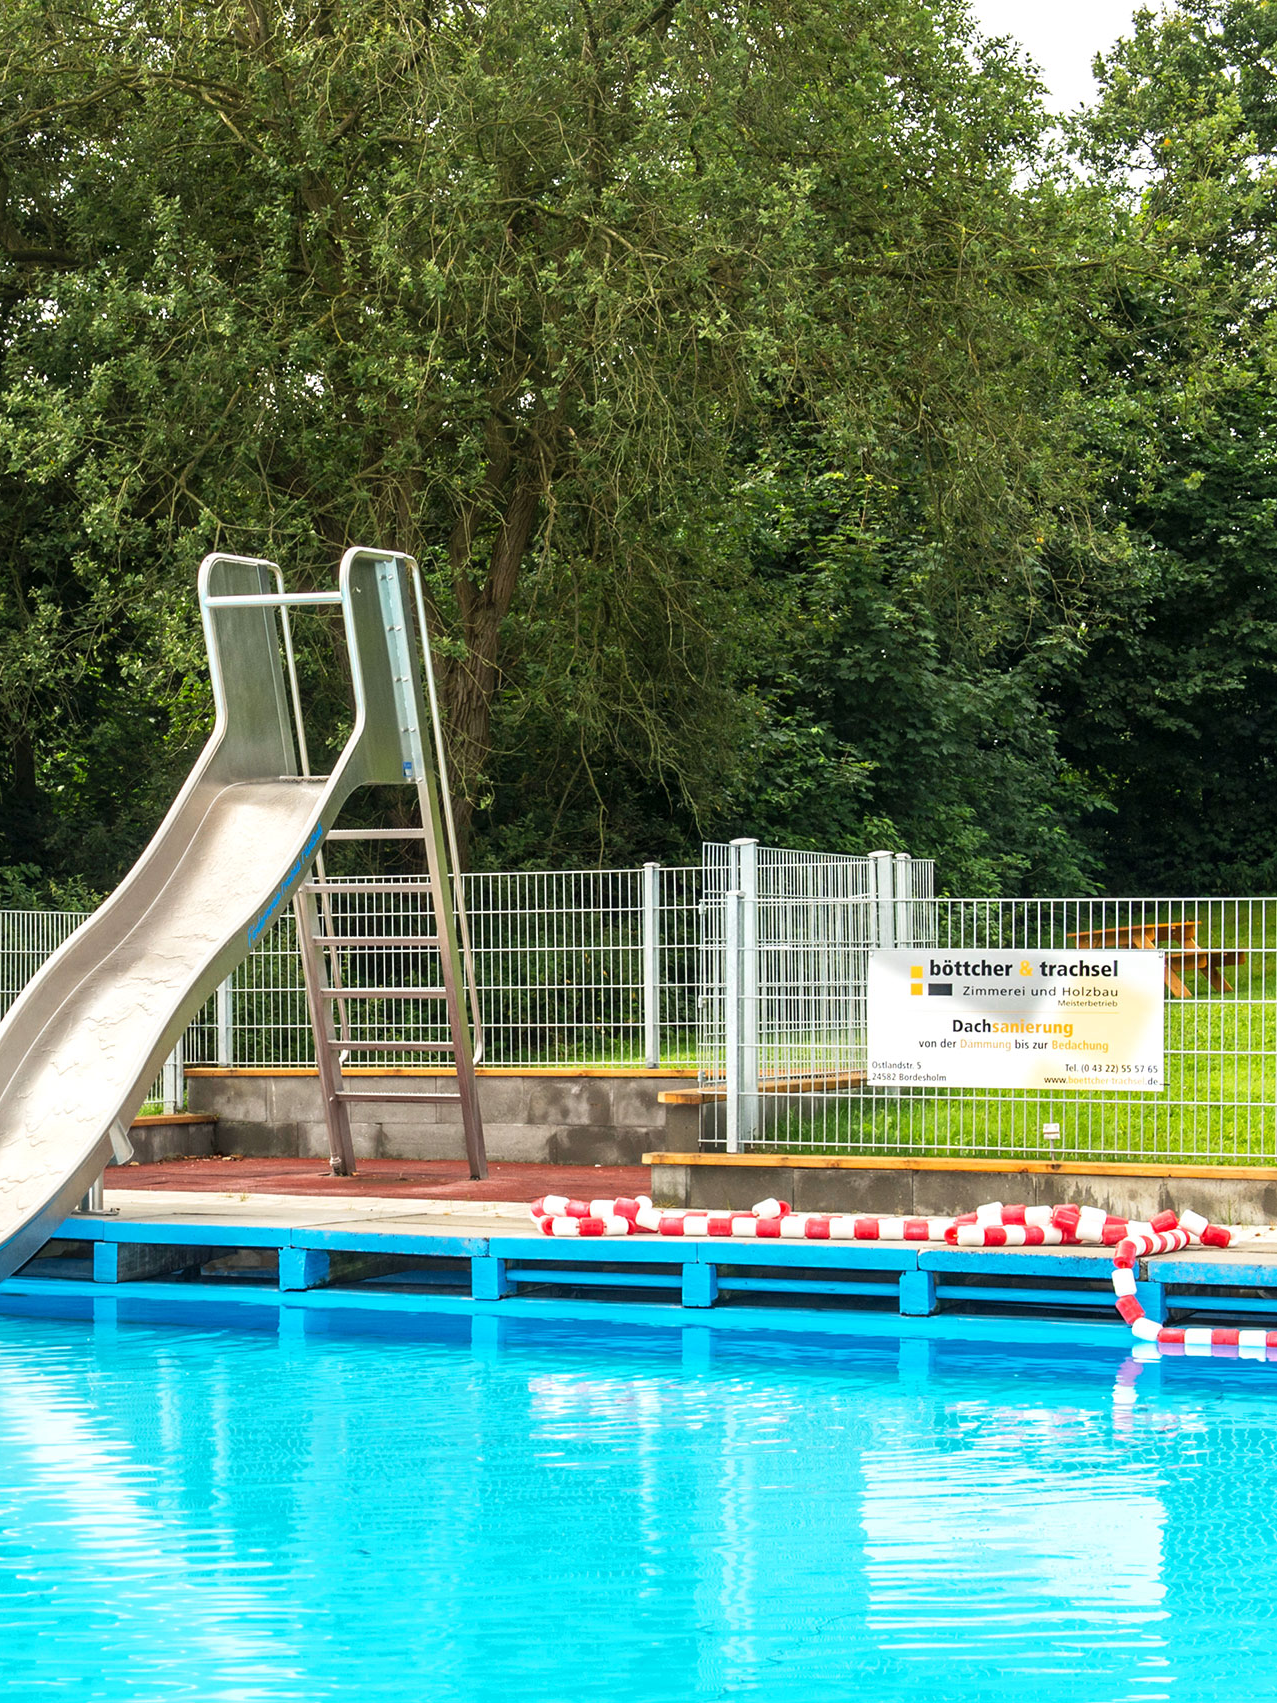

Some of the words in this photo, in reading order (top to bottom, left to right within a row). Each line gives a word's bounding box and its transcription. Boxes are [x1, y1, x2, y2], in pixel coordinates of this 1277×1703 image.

[930, 959, 1013, 977] böttcher
[1019, 960, 1034, 977] &
[1039, 960, 1119, 977] trachsel
[962, 986, 1025, 997] Zimmerei
[1031, 986, 1057, 997] und
[1062, 986, 1119, 998] Holzbau
[1057, 1000, 1119, 1008] Meisterbetrieb
[952, 1019, 1074, 1038] Dachsanierung
[918, 1040, 938, 1049] von
[939, 1039, 957, 1049] der
[1014, 1040, 1029, 1050] bis
[1032, 1041, 1049, 1050] zur
[1051, 1040, 1110, 1053] Bedachung
[871, 1061, 915, 1070] Ostlandstr.
[916, 1061, 922, 1070] 5
[1065, 1064, 1079, 1072] Tel.
[1081, 1064, 1090, 1074] (0
[1091, 1064, 1103, 1073] 43
[1105, 1064, 1119, 1074] 22)
[1121, 1064, 1132, 1073] 55
[1134, 1065, 1145, 1073] 57
[1147, 1065, 1159, 1074] 65
[871, 1073, 897, 1081] 24582
[898, 1073, 947, 1082] Bordesholm
